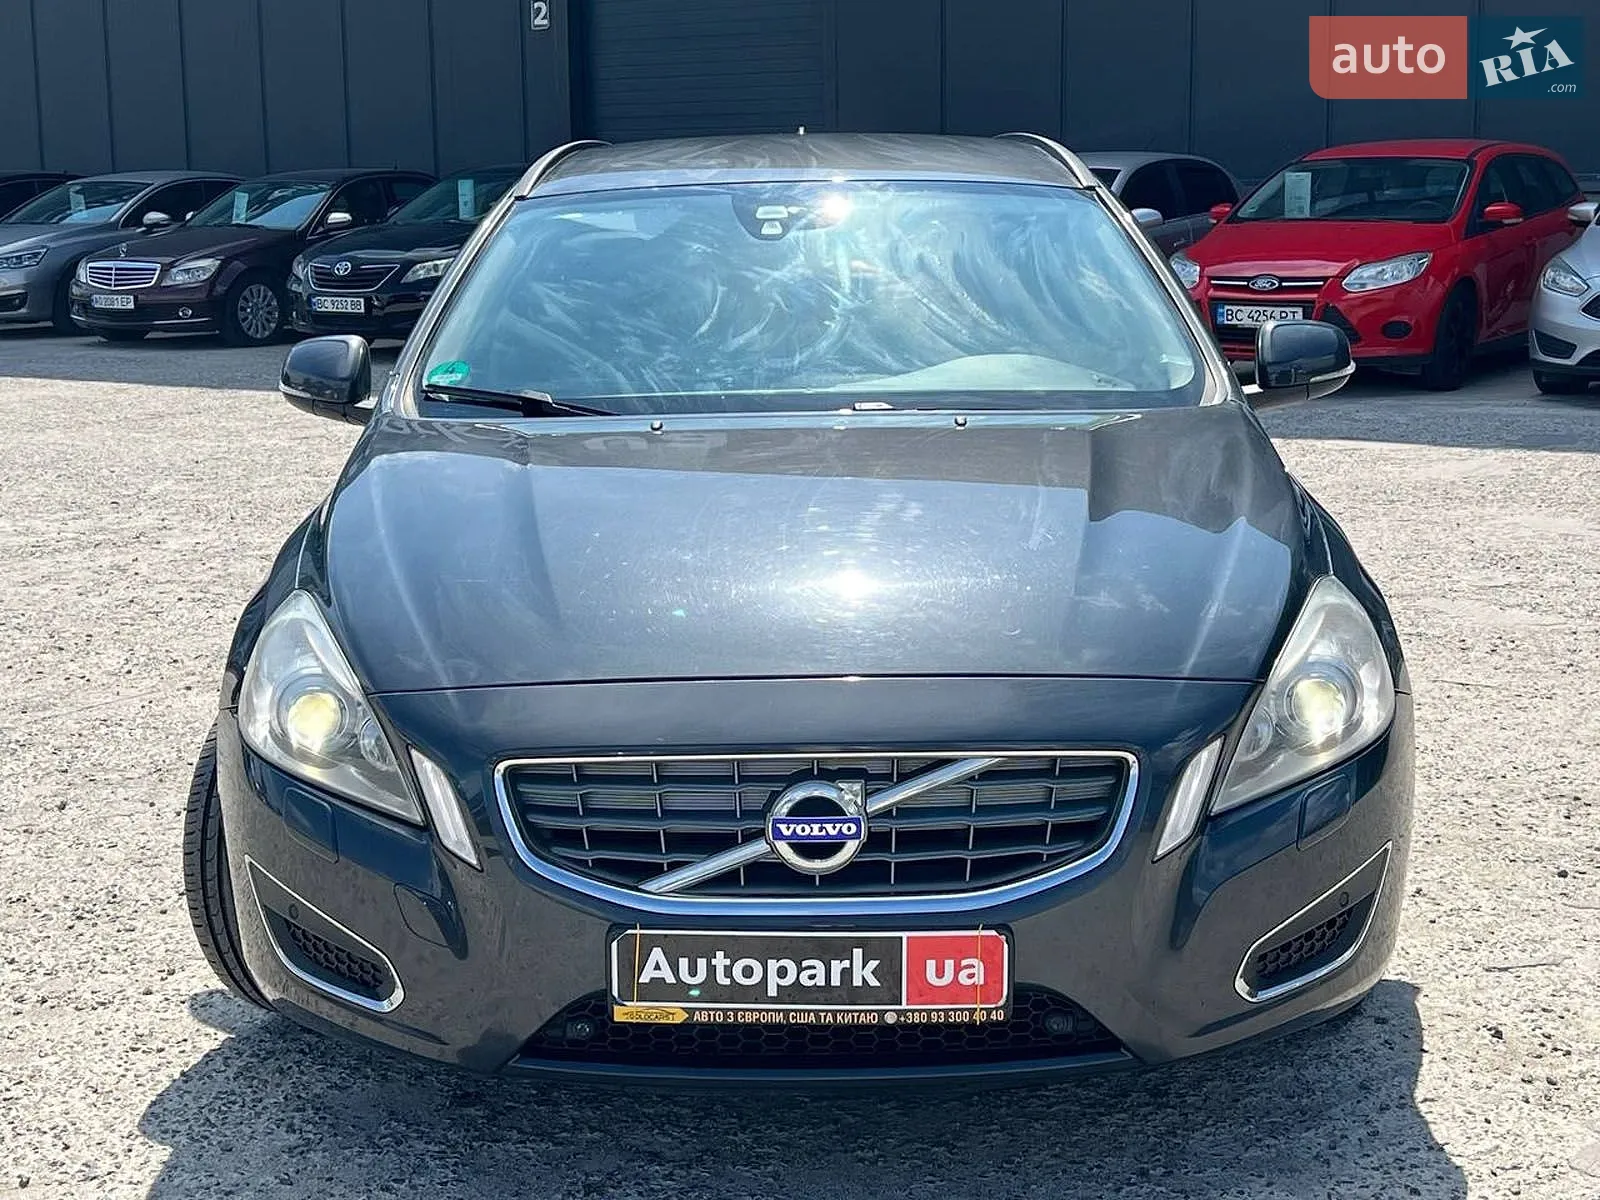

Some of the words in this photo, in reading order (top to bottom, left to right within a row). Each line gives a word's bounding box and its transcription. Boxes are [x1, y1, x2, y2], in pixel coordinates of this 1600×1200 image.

[533, 1, 548, 25] 2
[316, 298, 329, 310] BC
[330, 299, 349, 311] 9252
[1225, 308, 1244, 321] BC
[1247, 309, 1276, 322] 4256
[776, 822, 857, 836] VOLVO
[638, 946, 881, 997] Autopark
[925, 957, 985, 987] ua
[693, 1010, 724, 1022] АВТО
[737, 1011, 787, 1024] ЄВРОПИ,
[789, 1012, 816, 1024] США
[818, 1012, 834, 1024] ТА
[836, 1012, 878, 1024] КИТАЮ
[899, 1011, 928, 1024] +380
[931, 1011, 945, 1023] 93
[948, 1011, 970, 1022] 300
[973, 1010, 987, 1021] 40
[990, 1009, 1004, 1021] 40
